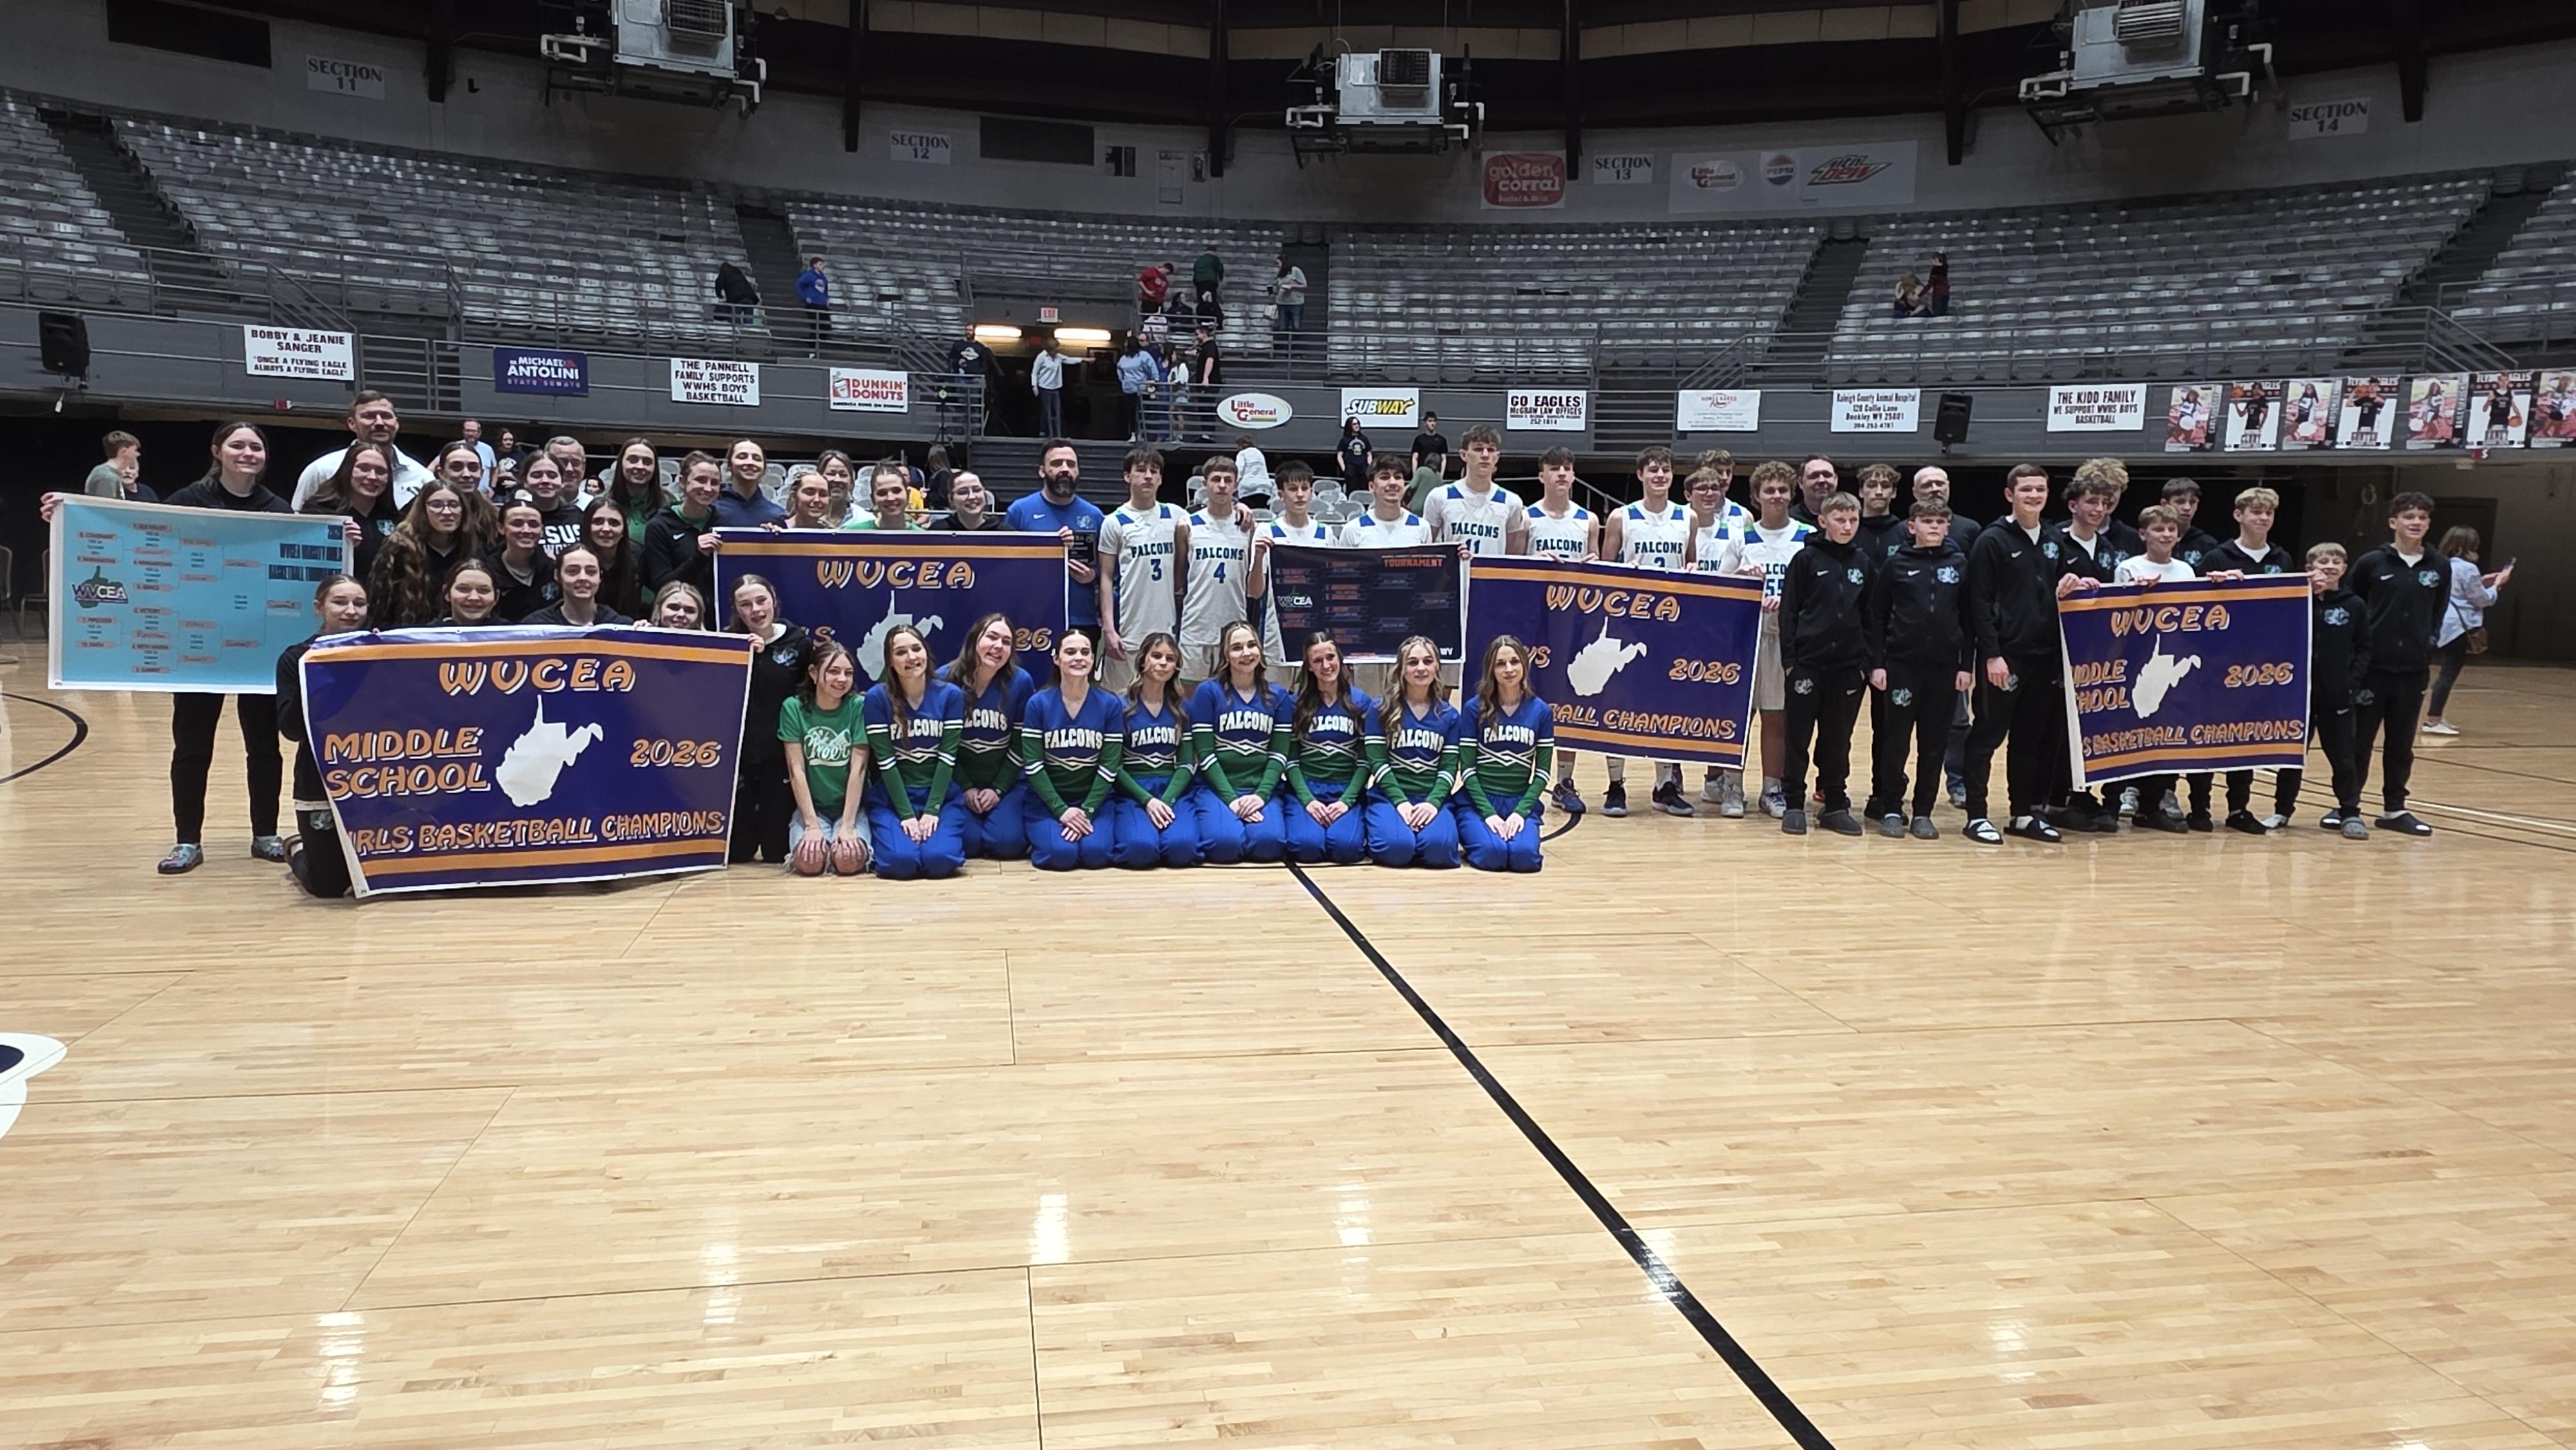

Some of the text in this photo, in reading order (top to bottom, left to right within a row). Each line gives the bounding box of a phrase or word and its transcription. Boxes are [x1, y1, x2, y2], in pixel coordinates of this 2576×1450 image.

[308, 59, 383, 82] SECTION
[336, 77, 355, 91] 11
[2291, 102, 2369, 122] SECTION
[2317, 118, 2338, 133] 14
[891, 133, 949, 149] SECTION
[913, 147, 929, 160] 12
[1595, 156, 1653, 169] SECTION
[1489, 163, 1554, 182] golden
[1615, 169, 1631, 180] 13
[1498, 176, 1560, 192] corral
[251, 329, 345, 345] BOBBY & JEANIE
[277, 342, 322, 353] SANGER
[291, 358, 319, 366] FLYING
[518, 357, 564, 367] MICHAEL
[681, 361, 749, 373] THE PANNELL
[507, 365, 579, 380] ANTOLINI
[675, 370, 755, 384] FAMILY SUPPORTS
[683, 382, 748, 393] WWHS BOYS
[852, 379, 906, 390] DUNKIN'
[686, 392, 744, 403] BASKETBALL
[852, 389, 904, 400] DONUTS
[1511, 395, 1528, 406] GO
[2058, 390, 2136, 404] THE KIDD FAMILY
[1231, 400, 1255, 412] Little
[1345, 398, 1416, 415] SUBWAY
[2065, 405, 2094, 414] SUPPORT
[2119, 404, 2137, 413] BOYS
[1237, 408, 1276, 422] General
[2076, 415, 2116, 424] BASKETBALL
[1451, 522, 1499, 539] FALCONS
[1131, 542, 1173, 558] FALCONS
[1535, 538, 1583, 553] FALCONS
[1634, 541, 1683, 554] FALCONS
[1196, 547, 1245, 561] FALCONS
[1150, 558, 1162, 581] 3
[1384, 558, 1443, 567] TOURNAMENT
[816, 560, 975, 588] WVCEA
[1213, 562, 1226, 584] 4
[1546, 585, 1680, 621] WVCEA
[2110, 605, 2230, 637] WVCEA
[439, 659, 636, 696] WVCEA
[1669, 658, 1741, 684] 2026
[2071, 659, 2128, 688] IDDLE
[2224, 662, 2293, 688] 2026
[1219, 711, 1274, 735] FALCONS
[1309, 715, 1354, 735] ALCONS
[1604, 710, 1737, 739] CHAMPIONS
[1044, 729, 1103, 750] FALCONS
[1391, 729, 1444, 753] FALCONS
[1484, 725, 1535, 746] FALCONS
[2094, 726, 2187, 755] BASKETBALL
[2190, 720, 2303, 745] CHAMPIONS
[324, 726, 484, 764] MIDDLE
[630, 739, 722, 768] 2026
[325, 762, 491, 800] SCHOOL
[418, 817, 597, 849] BASKETBALL
[600, 811, 726, 842] CHAMPIONS
